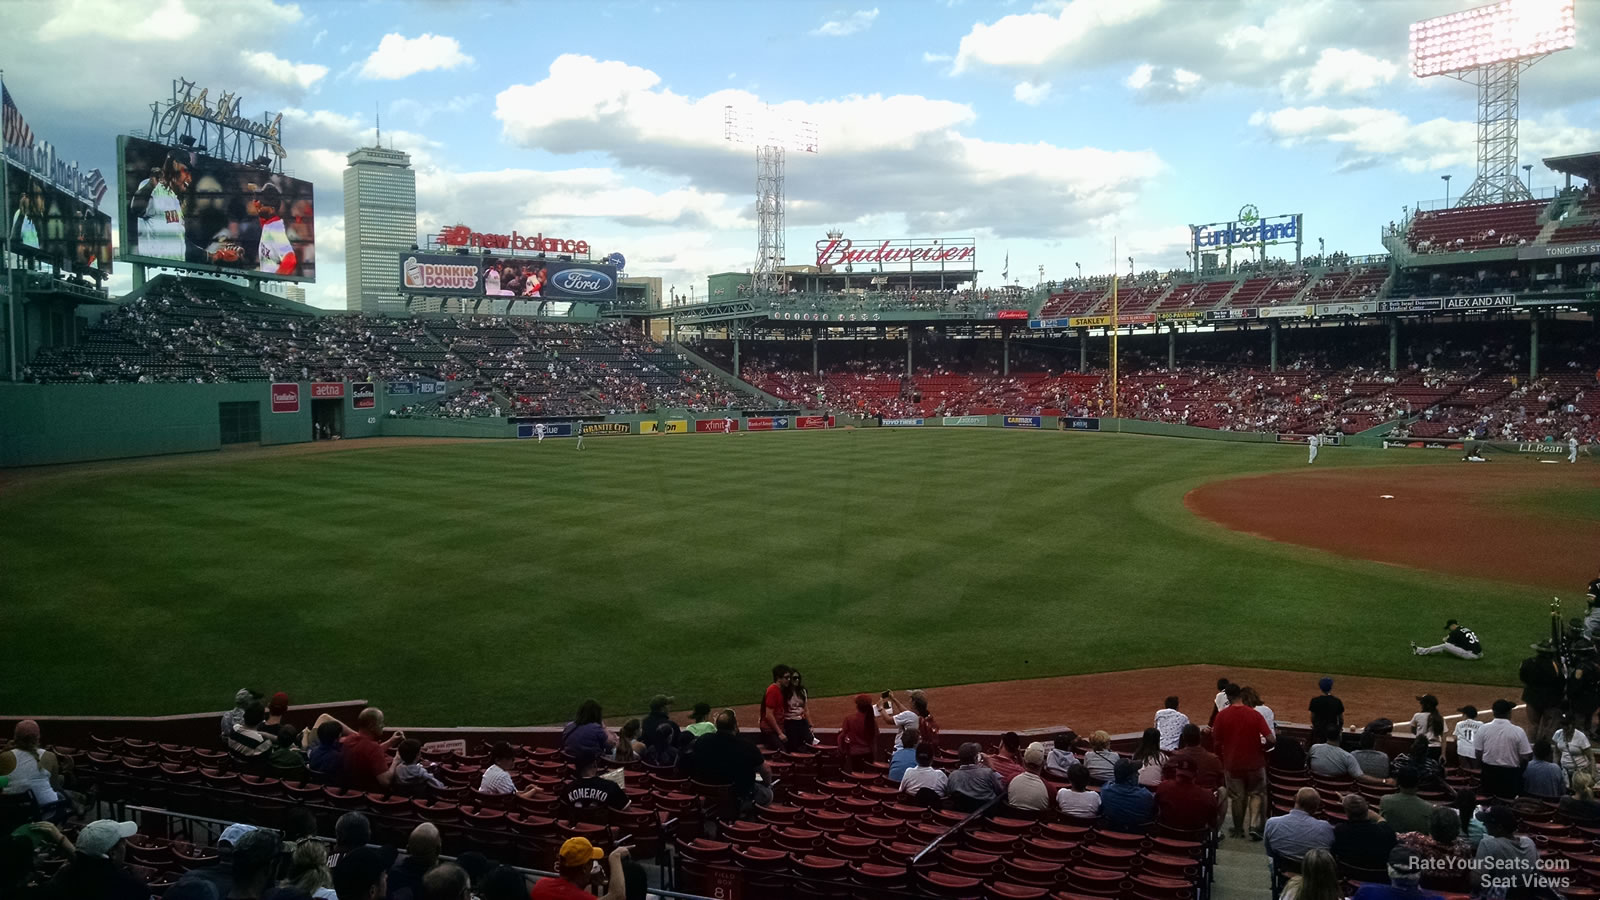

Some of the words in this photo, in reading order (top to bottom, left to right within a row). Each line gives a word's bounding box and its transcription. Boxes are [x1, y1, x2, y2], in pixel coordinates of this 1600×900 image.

[157, 76, 212, 138] John
[213, 89, 286, 156] Hancock
[1195, 215, 1296, 247] Cumberland
[815, 238, 976, 266] Budweiser
[1546, 246, 1587, 256] TONIGHT'S
[425, 265, 477, 277] DUNKIN'
[425, 276, 475, 288] DONUTS
[564, 272, 600, 290] Ford
[1447, 298, 1470, 308] ALEX
[1472, 297, 1492, 307] AND
[1494, 296, 1512, 305] ANI
[1076, 317, 1105, 326] STANLEY
[316, 384, 340, 396] aetna
[583, 423, 613, 433] GRANITE
[614, 423, 630, 433] CITY
[705, 421, 726, 431] xfinit
[567, 787, 608, 803] KONERKO
[713, 886, 733, 900] 81
